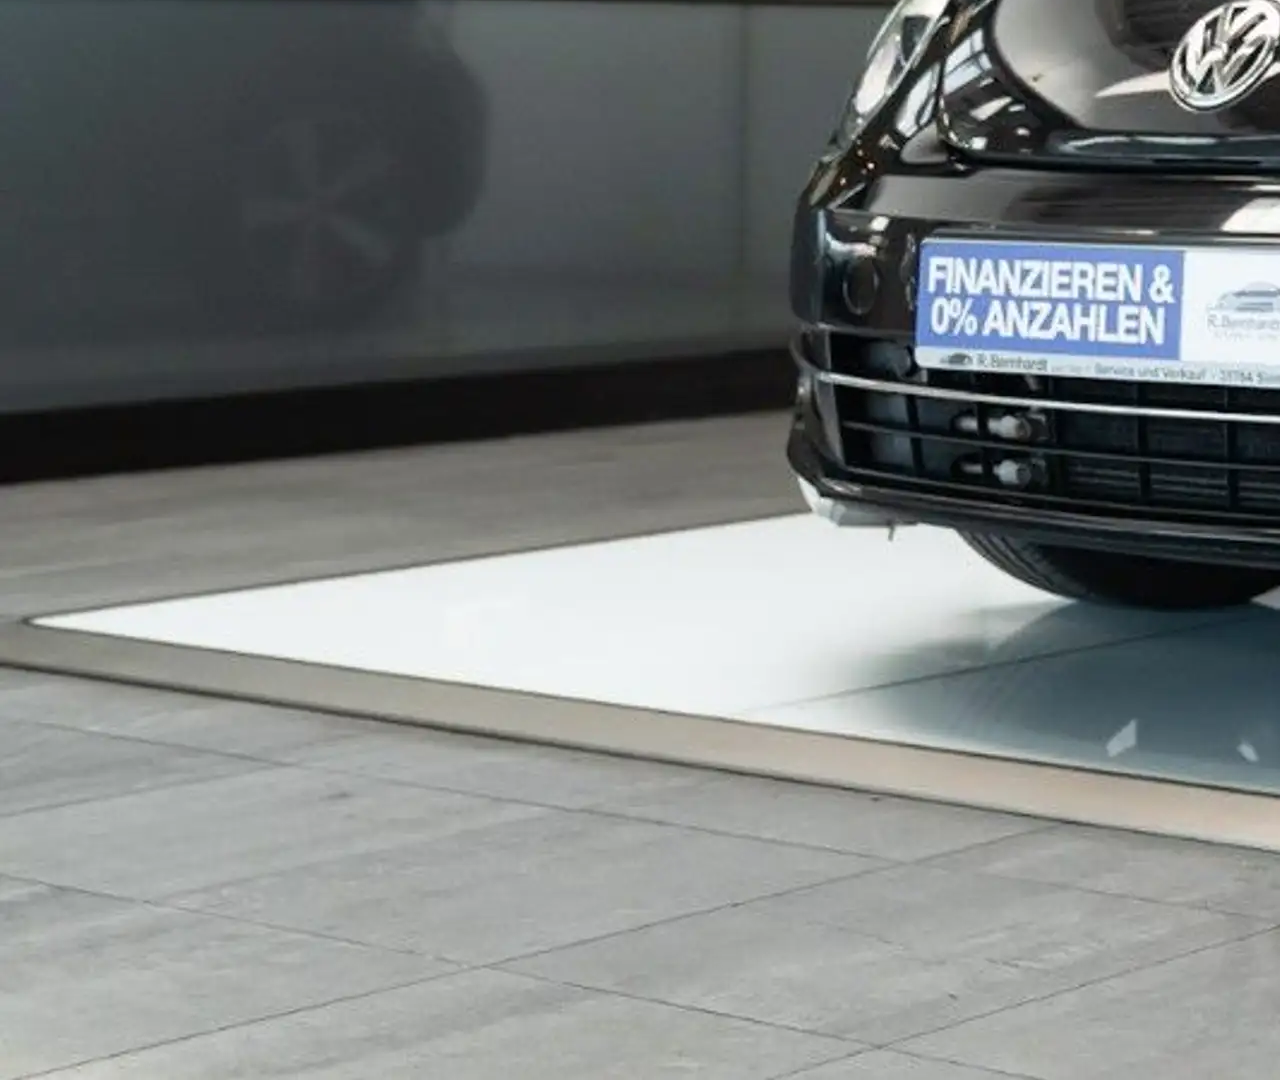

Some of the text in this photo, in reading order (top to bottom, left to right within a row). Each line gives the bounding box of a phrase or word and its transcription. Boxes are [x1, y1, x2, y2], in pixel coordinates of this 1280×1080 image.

[928, 256, 1175, 304] FINANZIEREN &
[931, 296, 1165, 344] 0% ANZAHLEN
